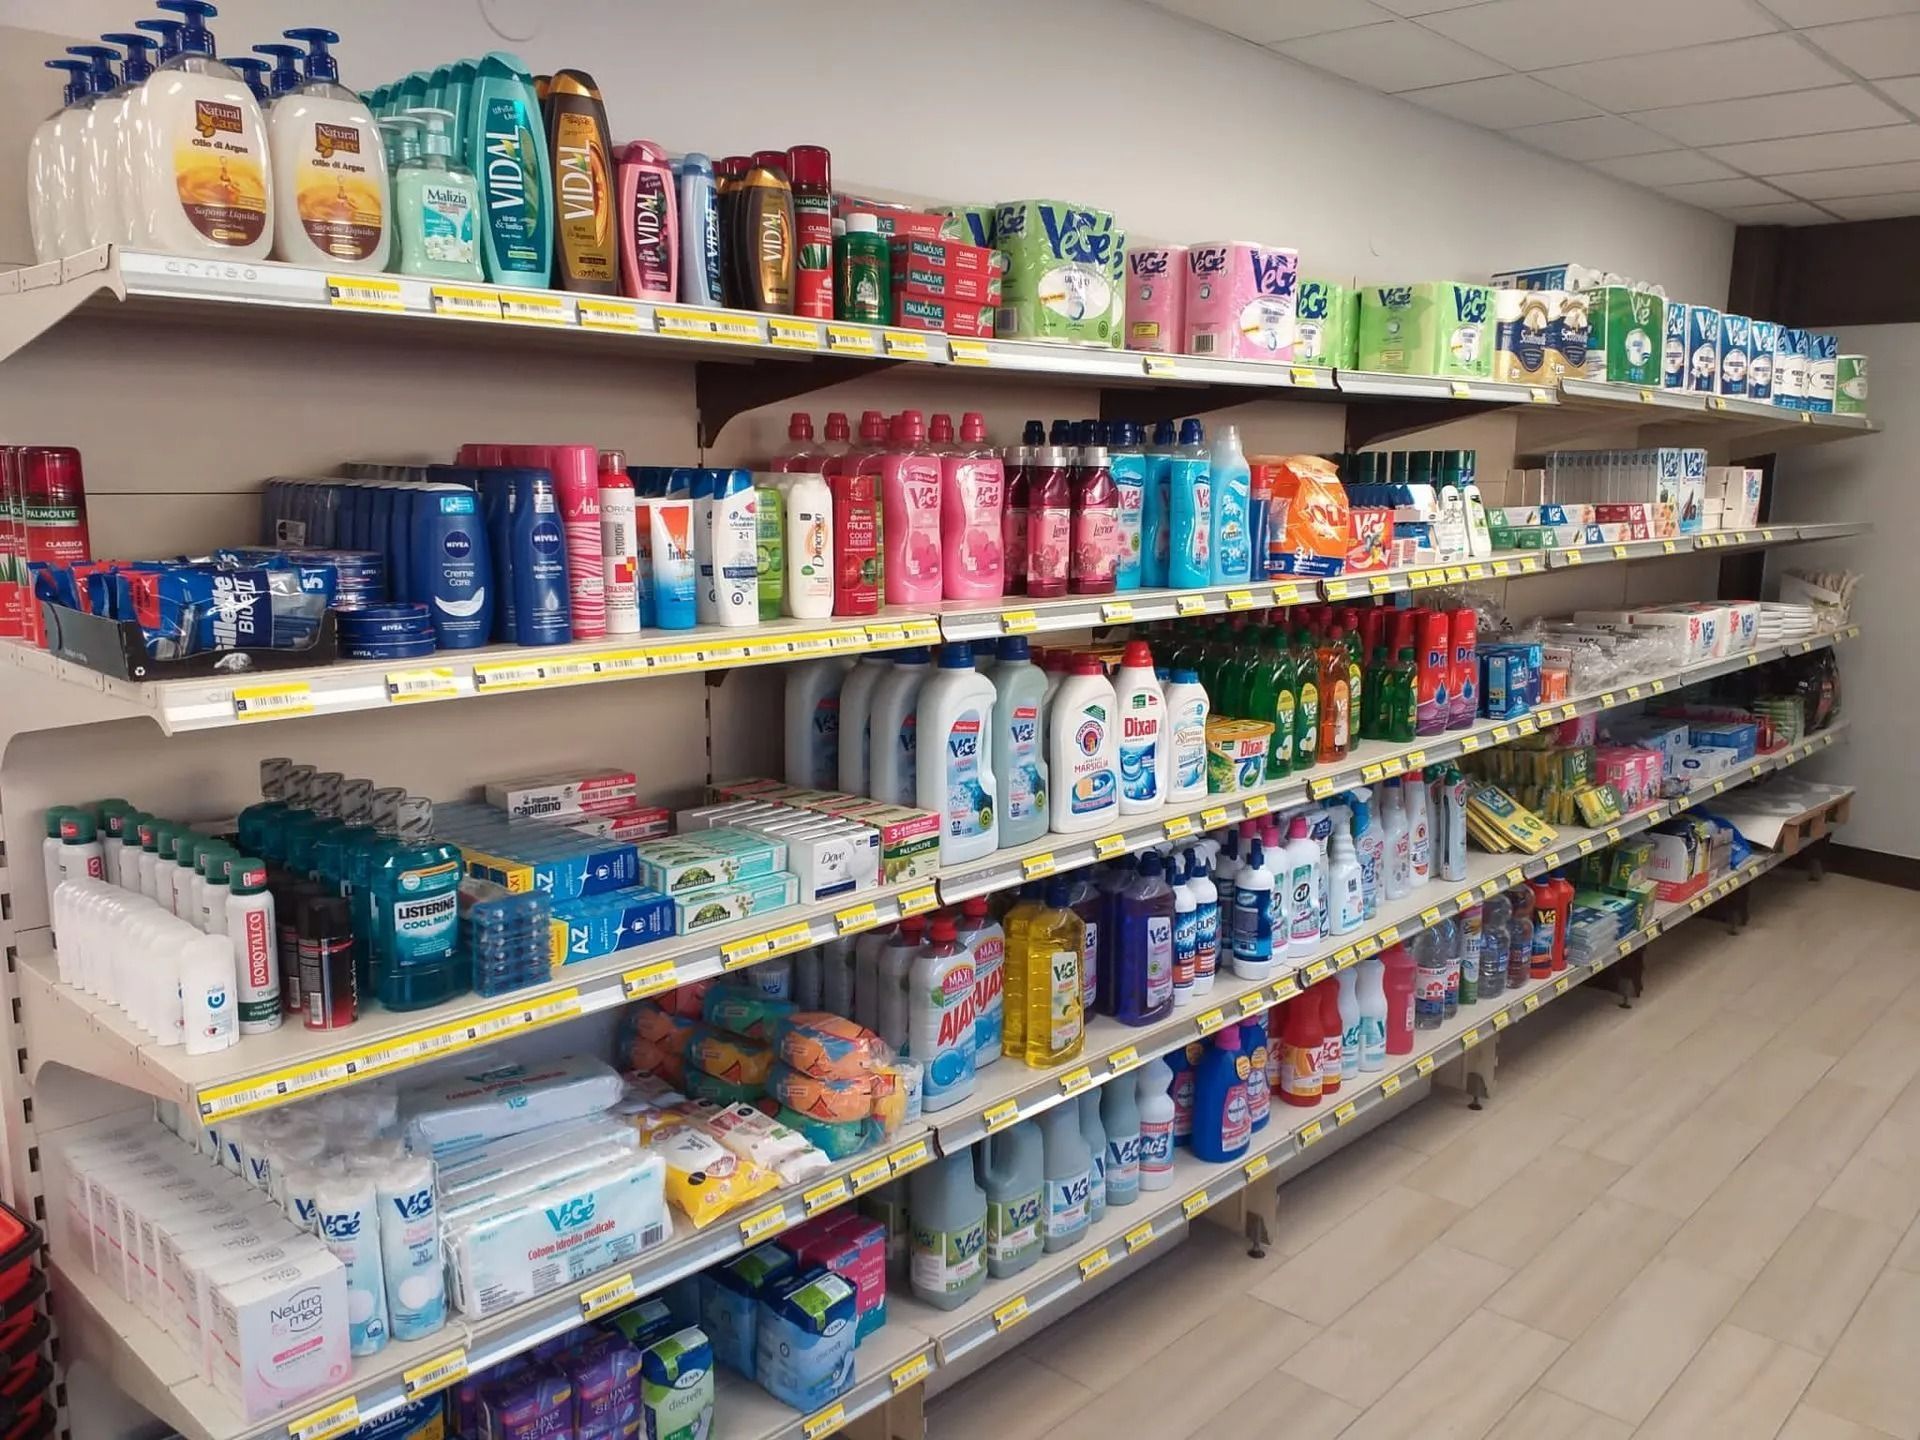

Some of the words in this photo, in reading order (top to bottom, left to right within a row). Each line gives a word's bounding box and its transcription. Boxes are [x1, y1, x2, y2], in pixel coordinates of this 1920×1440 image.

[198, 103, 241, 120] Natural
[318, 125, 358, 142] Natural
[486, 125, 525, 210] VIDAL
[560, 140, 596, 220] VIDAL
[427, 188, 467, 206] Malizia
[637, 189, 660, 246] VIDAL
[762, 210, 783, 262] VIDAL
[912, 242, 944, 257] PALMOLIVE
[911, 271, 943, 285] PALMOLIVE
[905, 303, 944, 318] PALMOLIVE
[26, 509, 77, 520] PALMOLIVE
[446, 541, 469, 549] NIVEA
[534, 534, 559, 543] NIVEA
[444, 568, 475, 578] Creme
[449, 577, 472, 587] Care
[1124, 717, 1157, 738] Dixan
[1240, 740, 1264, 757] Dixan
[514, 800, 561, 817] Capitano
[899, 840, 932, 855] PALMOLIVE
[820, 850, 846, 865] Dove
[398, 895, 456, 919] LISTERINE
[402, 917, 431, 930] COOL
[432, 913, 456, 927] MINT
[571, 925, 589, 954] AZ
[249, 913, 267, 985] BOROTALCO
[937, 997, 976, 1046] AJAX
[1144, 1136, 1168, 1157] ACE
[528, 1244, 556, 1261] Cotone
[555, 1232, 583, 1250] idrofilo
[583, 1219, 616, 1240] medicale
[271, 1294, 321, 1323] Neutro
[289, 1303, 323, 1328] med
